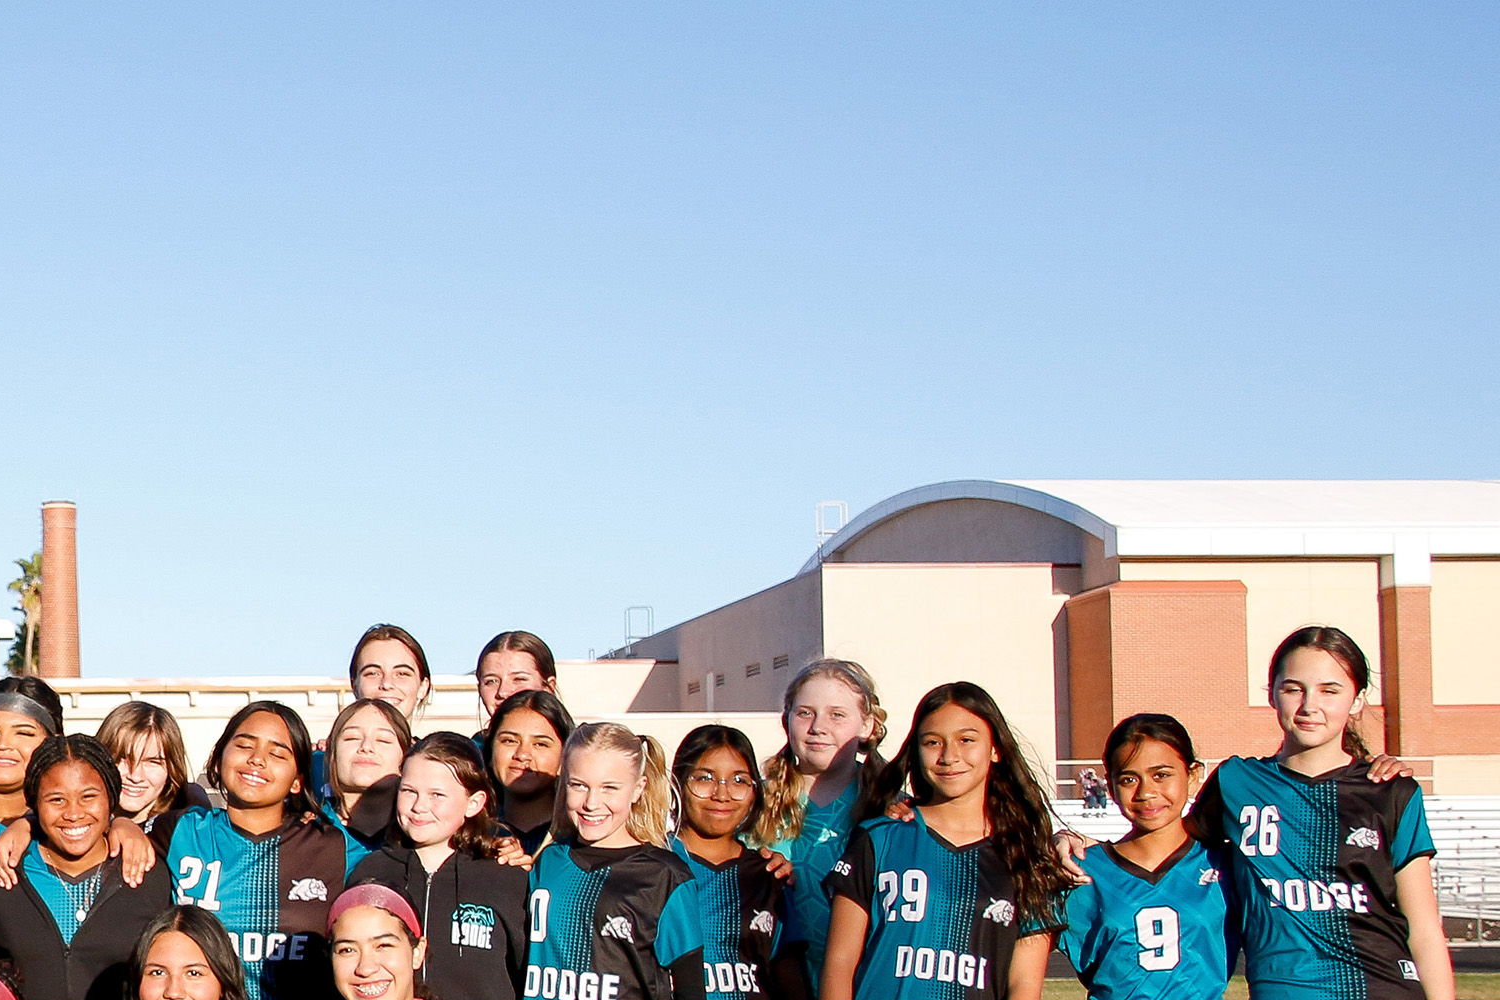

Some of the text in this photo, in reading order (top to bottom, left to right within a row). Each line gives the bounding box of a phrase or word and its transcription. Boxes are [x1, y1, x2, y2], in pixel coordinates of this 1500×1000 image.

[1238, 805, 1280, 856] 26
[177, 856, 221, 911] 21
[879, 869, 928, 922] 29
[1261, 878, 1369, 912] DODGE
[1135, 906, 1180, 971] 9
